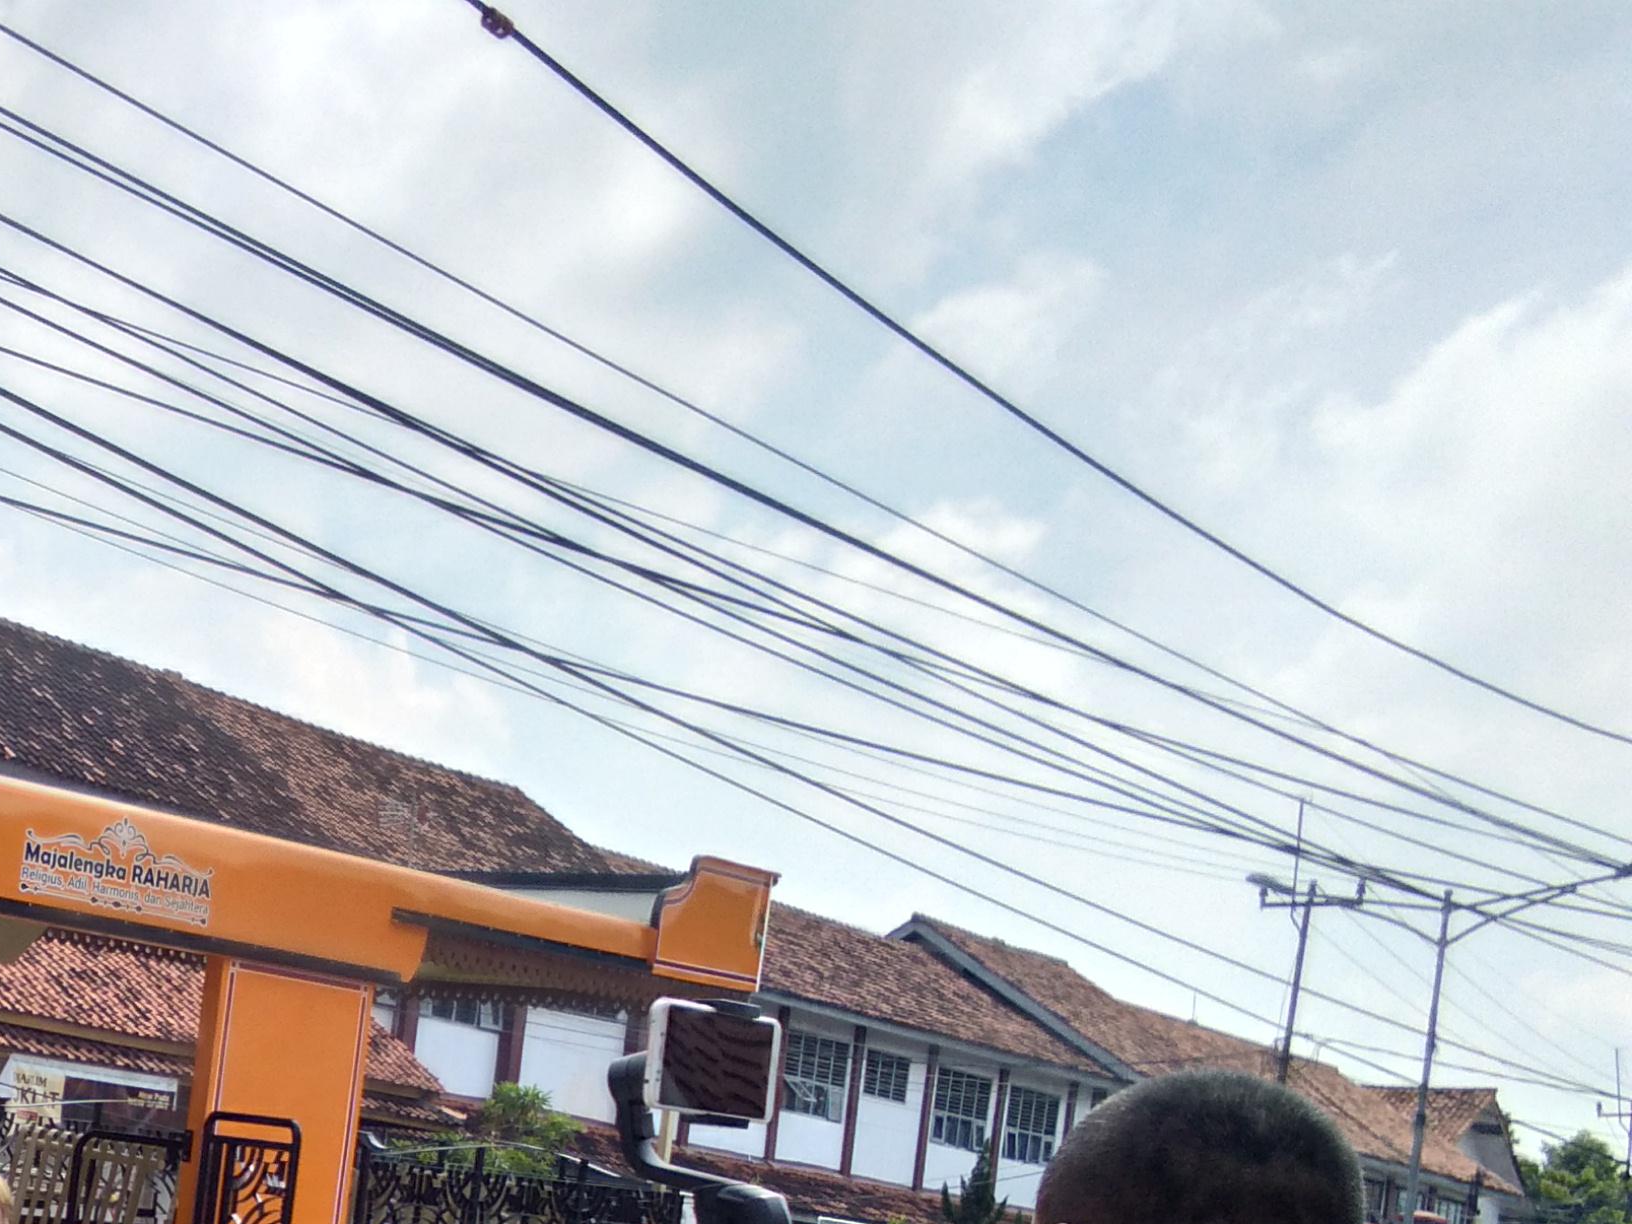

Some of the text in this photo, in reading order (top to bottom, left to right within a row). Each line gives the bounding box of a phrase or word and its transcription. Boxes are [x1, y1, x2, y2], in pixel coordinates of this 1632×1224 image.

[24, 842, 211, 899] Majalengka RAHARJA
[144, 892, 162, 905] dan
[165, 896, 209, 915] Sejahtera
